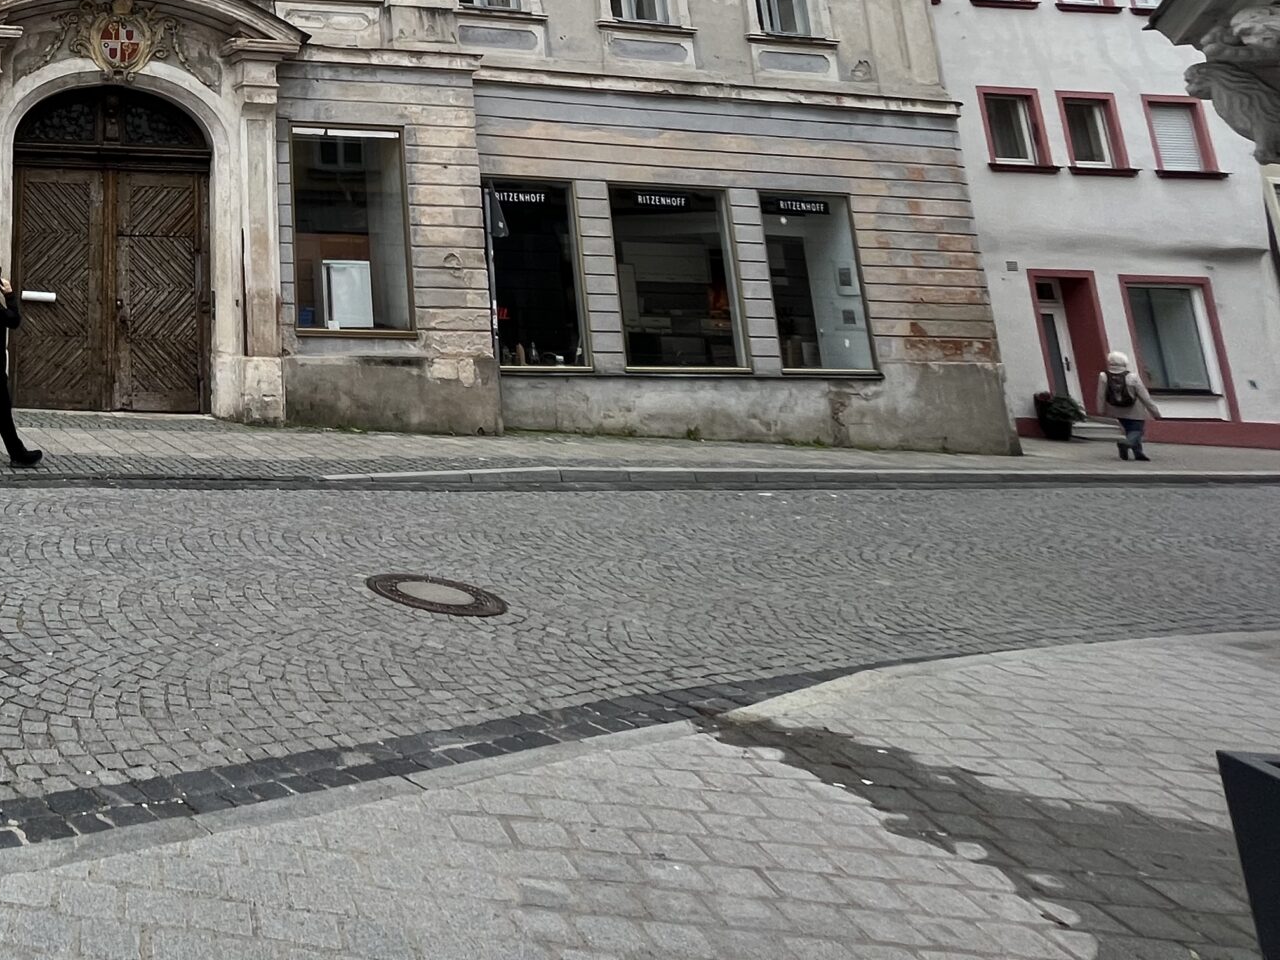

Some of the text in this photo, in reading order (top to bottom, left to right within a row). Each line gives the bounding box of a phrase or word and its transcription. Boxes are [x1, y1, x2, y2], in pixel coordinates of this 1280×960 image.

[494, 191, 545, 203] RITZENHOFF
[637, 194, 686, 207] RITZENHOFF
[779, 200, 825, 212] RITZENHOFF
